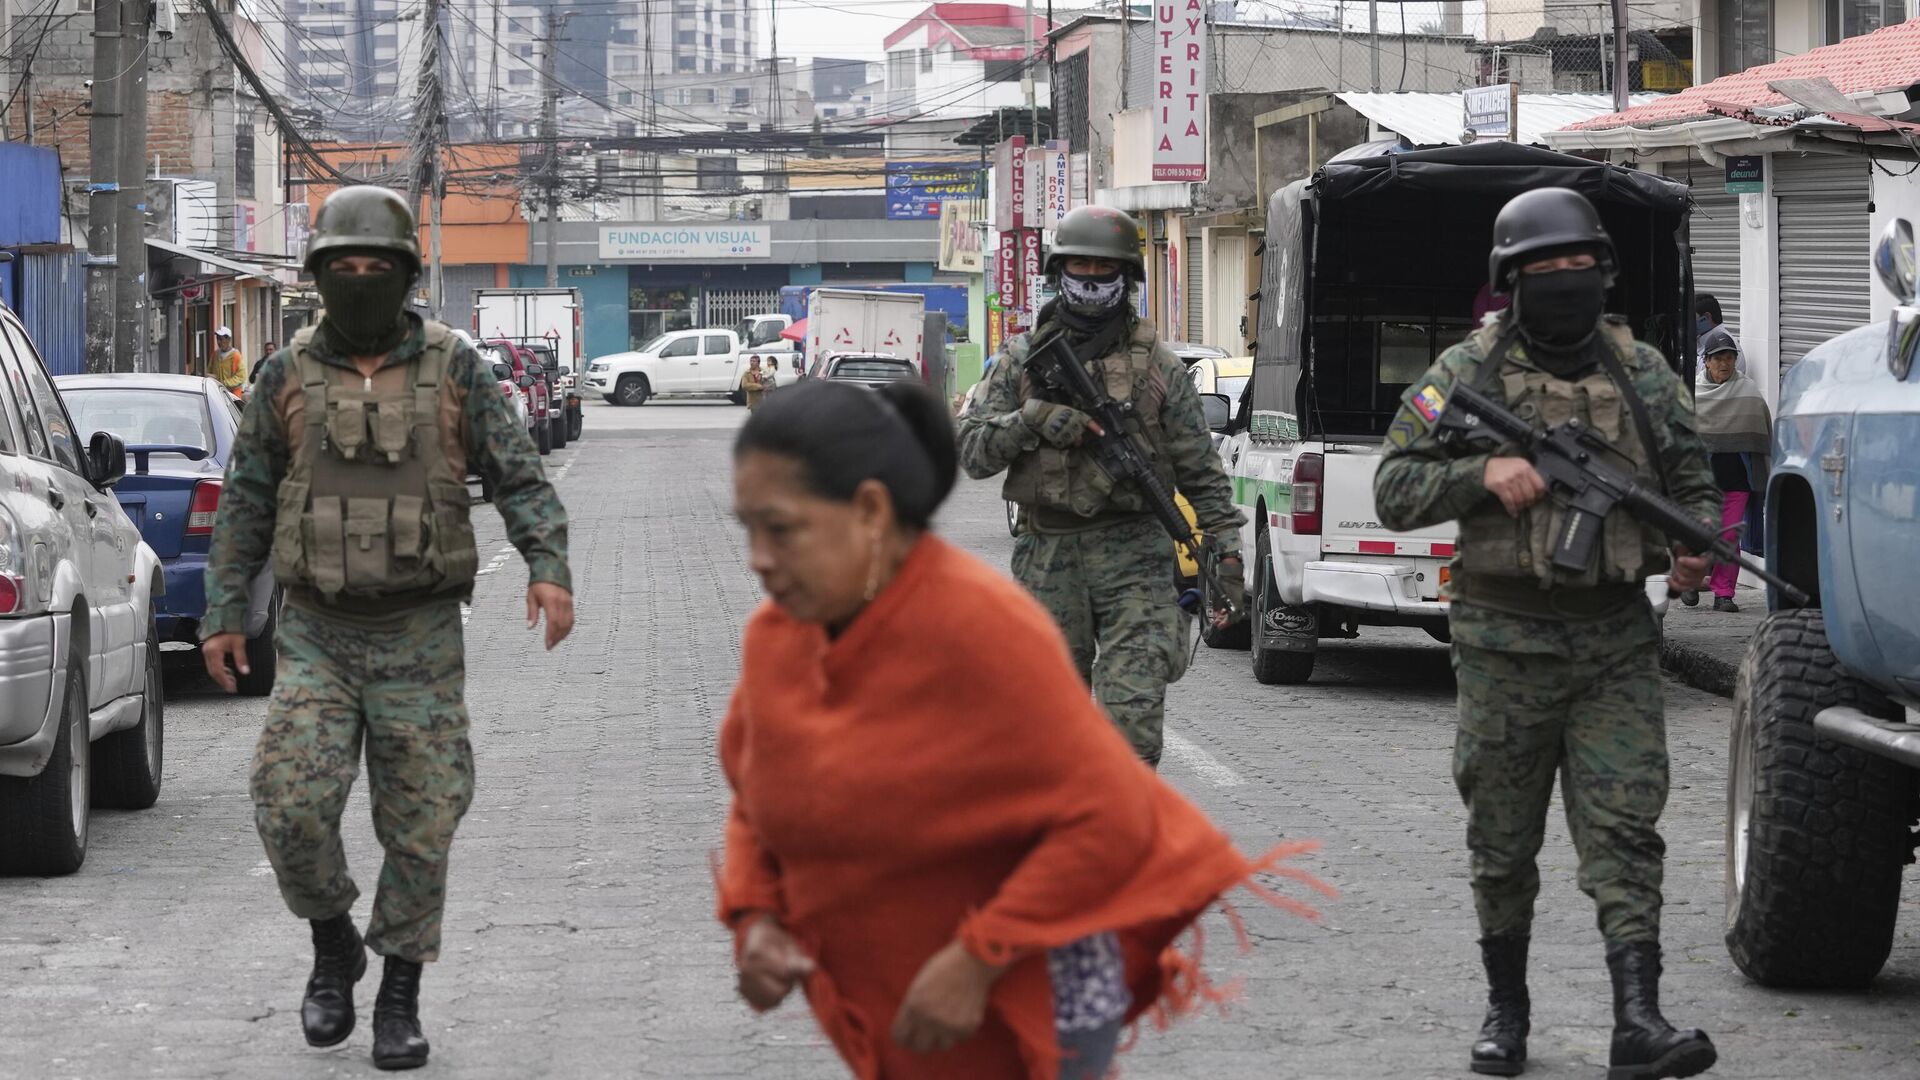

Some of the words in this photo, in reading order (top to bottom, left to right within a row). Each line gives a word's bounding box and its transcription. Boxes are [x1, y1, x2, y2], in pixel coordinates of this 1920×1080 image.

[1158, 6, 1173, 151] UTERIA
[1013, 147, 1024, 213] POLLOS
[1049, 176, 1057, 209] ROPA
[608, 229, 700, 244] FUNDACIÓN
[705, 231, 760, 244] VISUAL
[1001, 237, 1014, 305] POLLOS
